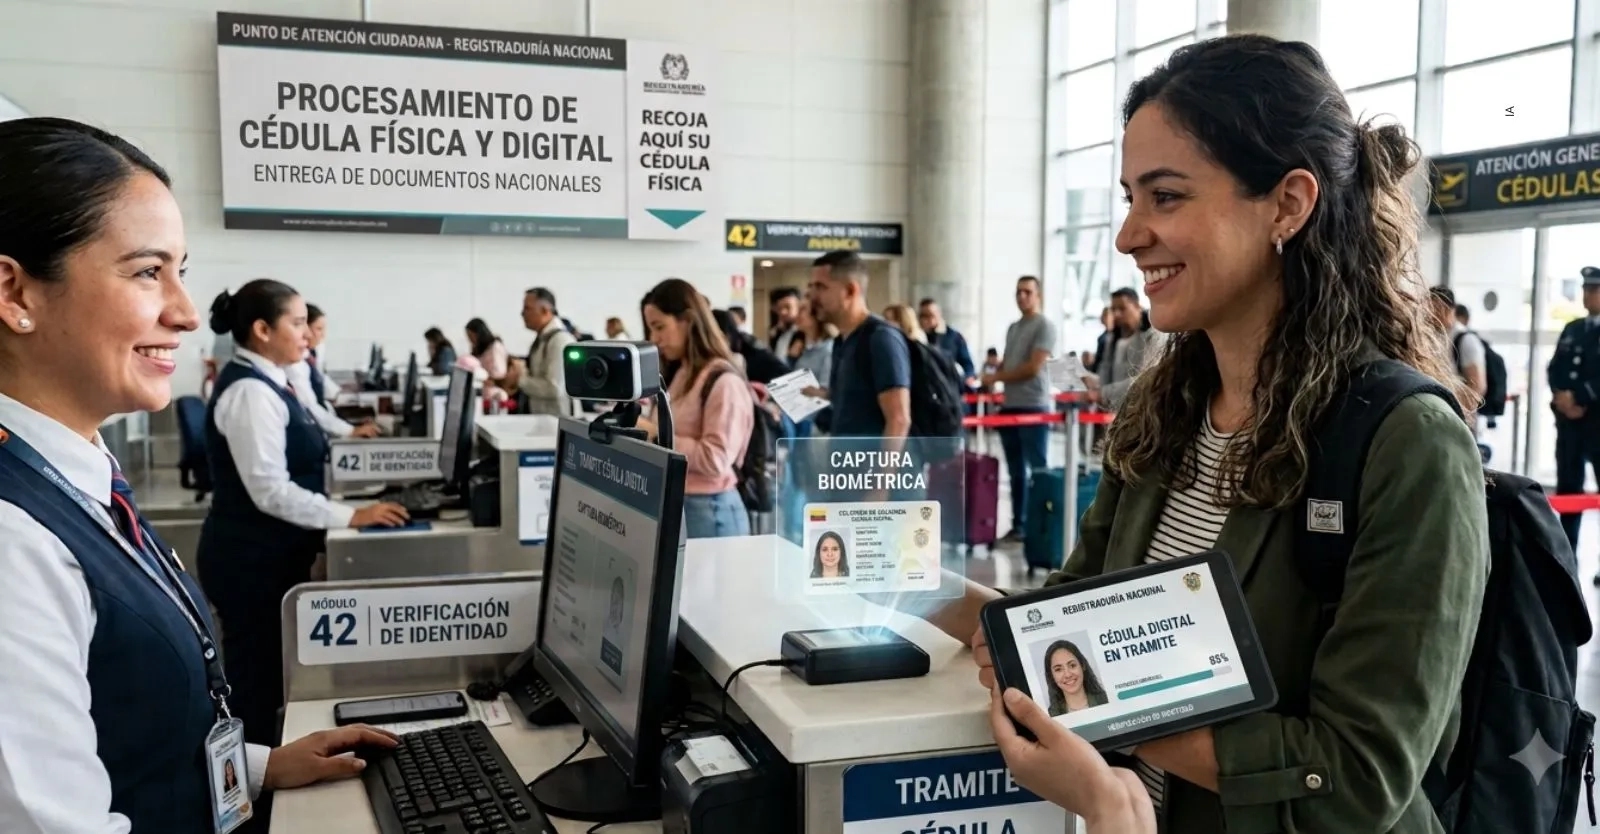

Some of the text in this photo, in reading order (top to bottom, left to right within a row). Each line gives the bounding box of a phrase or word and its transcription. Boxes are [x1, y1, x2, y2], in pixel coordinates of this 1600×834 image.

[232, 23, 278, 40] PUNTO
[281, 26, 298, 41] DE
[301, 28, 366, 45] ATENCIÓN
[369, 32, 444, 50] CIUDADANA
[454, 37, 550, 57] REGISTRADURÍA
[553, 44, 614, 60] NACIONAL
[277, 81, 578, 123] PROCESAMIENTO DE
[642, 109, 708, 128] RECOJA
[239, 113, 613, 162] CÉDULA FÍSICA Y DIGITAL
[640, 129, 710, 149] AQUÍ SU
[640, 149, 710, 171] CÉDULA
[1475, 142, 1600, 175] ATENCIÓN GENE
[254, 164, 602, 193] ENTREGA DE DOCUMENTOS NACIONALES
[648, 172, 702, 191] FÍSICA
[727, 223, 758, 248] 42
[337, 454, 361, 472] 42
[369, 462, 382, 472] DE
[830, 451, 914, 469] CAPTURA
[817, 469, 927, 491] BIOMÉTRICA
[311, 597, 357, 611] MÓDULO
[379, 597, 510, 624] VERIFICACIÓN
[309, 612, 358, 647] 42
[380, 622, 508, 645] DE IDENTIDAD
[1099, 613, 1196, 646] CÉDULA DIGITAL
[1103, 635, 1178, 663] EN TRAMITE
[1208, 652, 1230, 666] 85%
[895, 768, 1020, 805] TRAMITE
